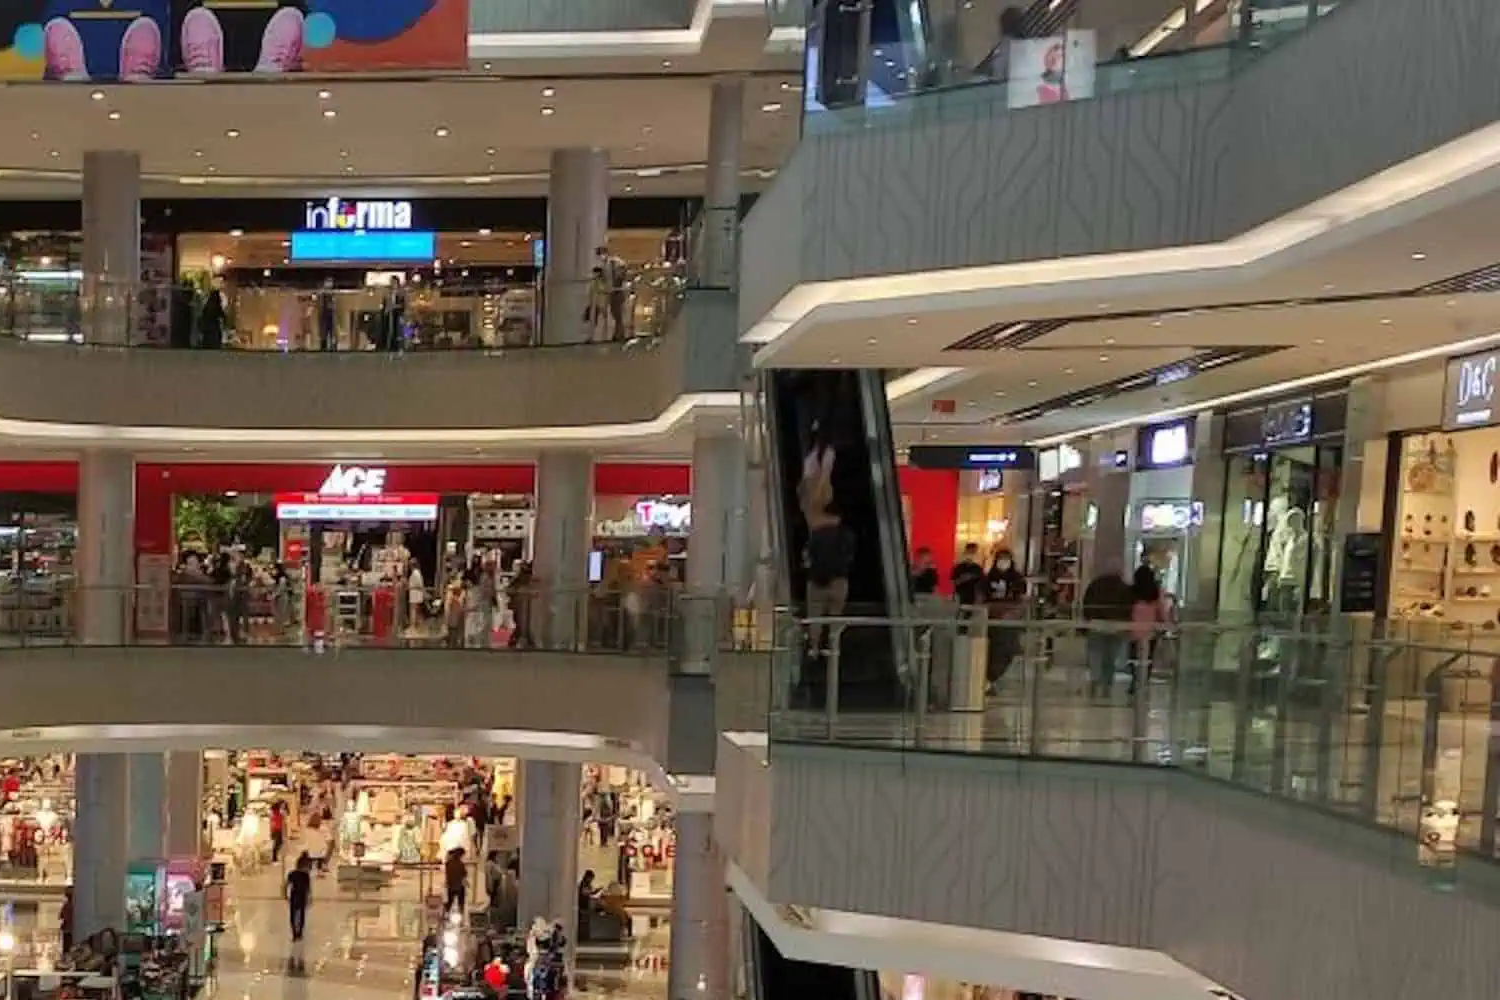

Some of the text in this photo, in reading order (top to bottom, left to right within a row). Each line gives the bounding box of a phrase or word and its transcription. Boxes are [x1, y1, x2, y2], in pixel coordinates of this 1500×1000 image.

[306, 196, 412, 229] informa
[318, 464, 387, 497] ACE
[635, 500, 692, 529] Toy
